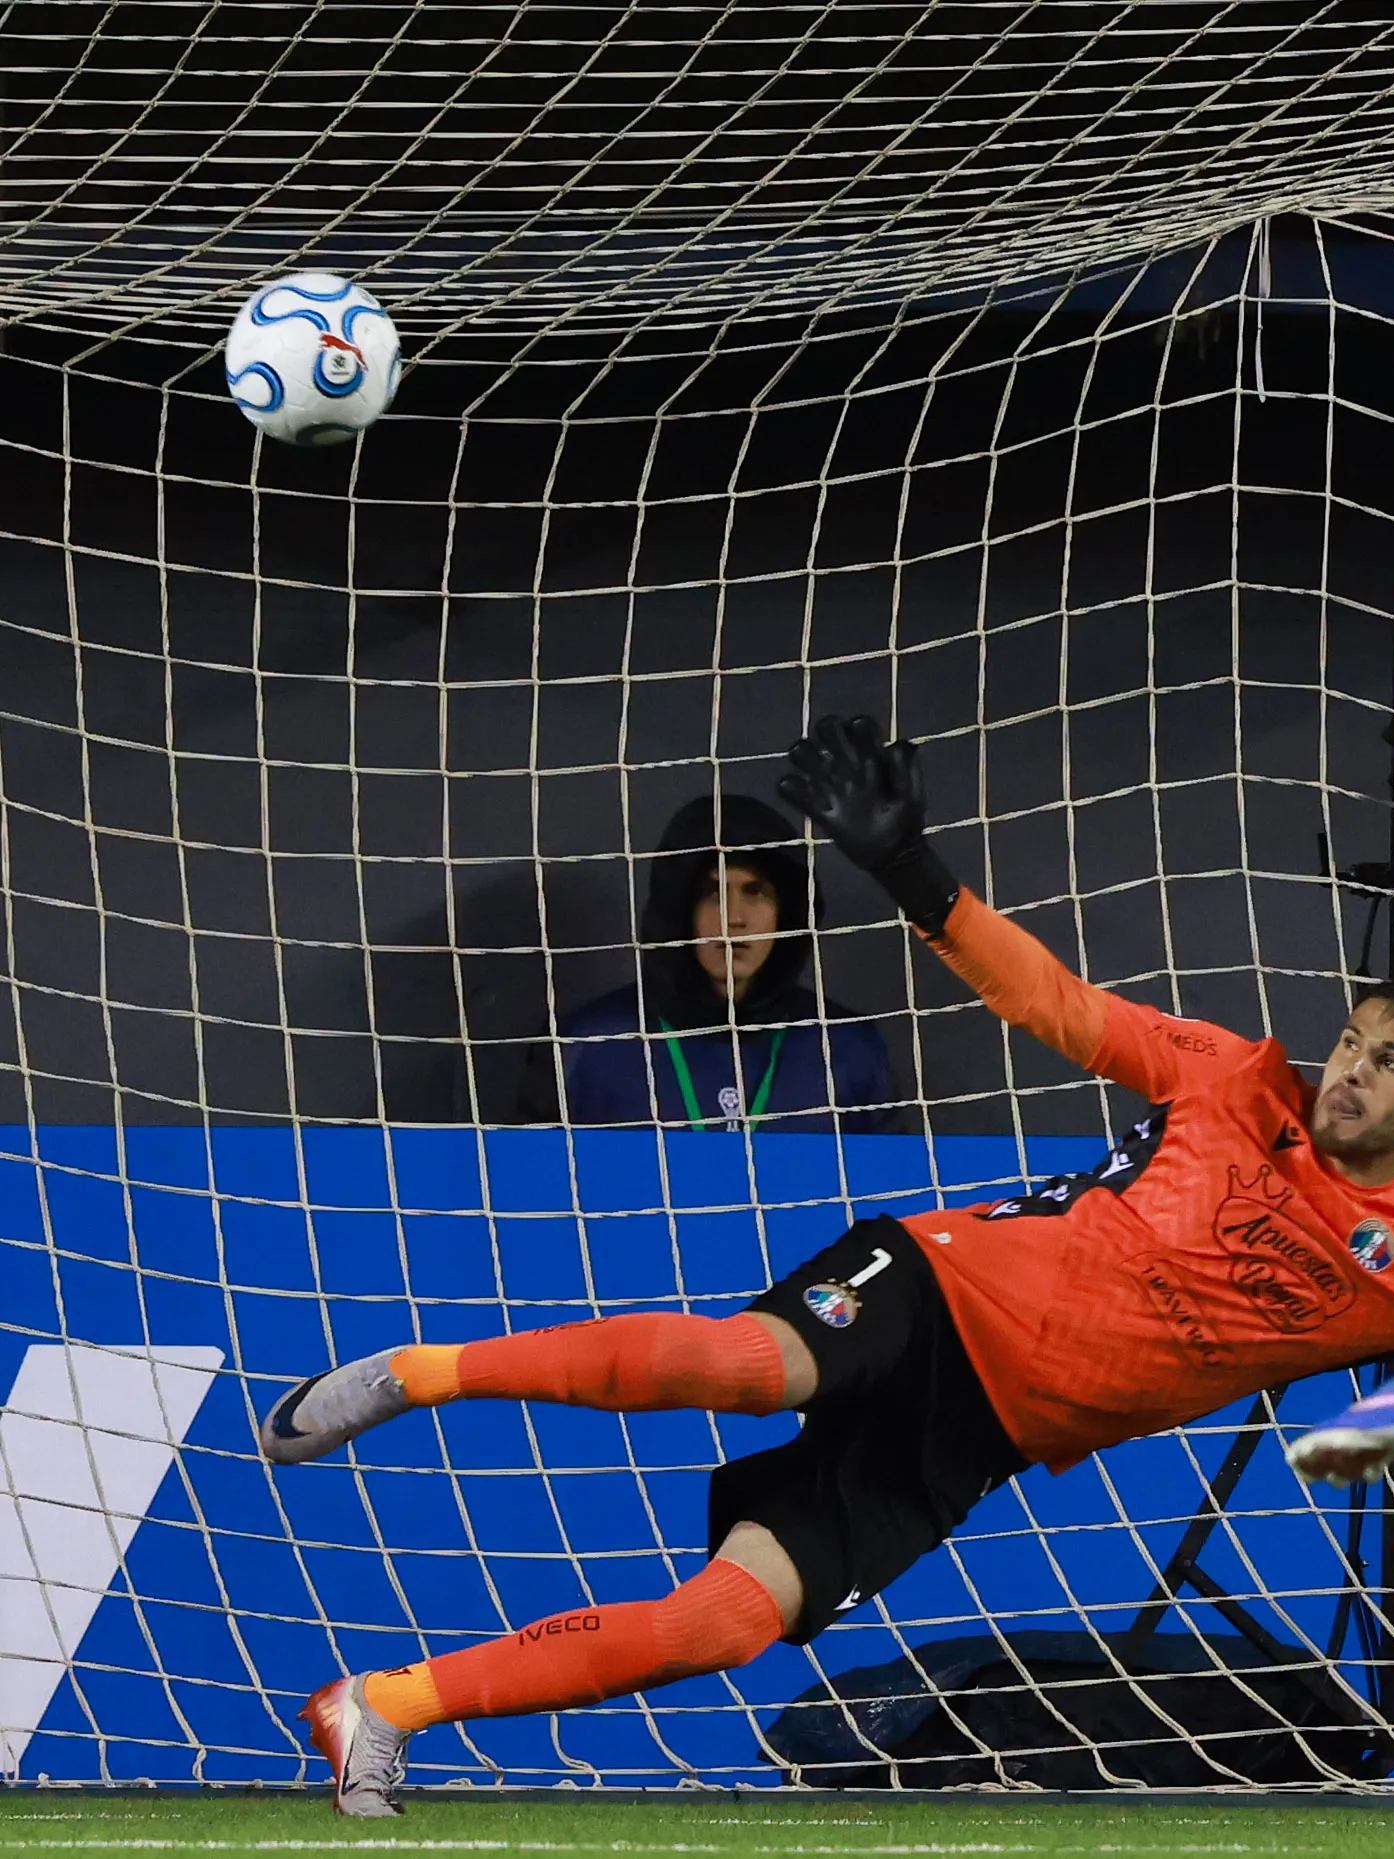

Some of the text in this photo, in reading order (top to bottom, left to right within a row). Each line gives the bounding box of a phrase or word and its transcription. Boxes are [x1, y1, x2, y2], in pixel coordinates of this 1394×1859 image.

[847, 1248, 893, 1288] 1
[1223, 1214, 1347, 1303] Apuestas
[519, 1615, 601, 1648] IVECO
